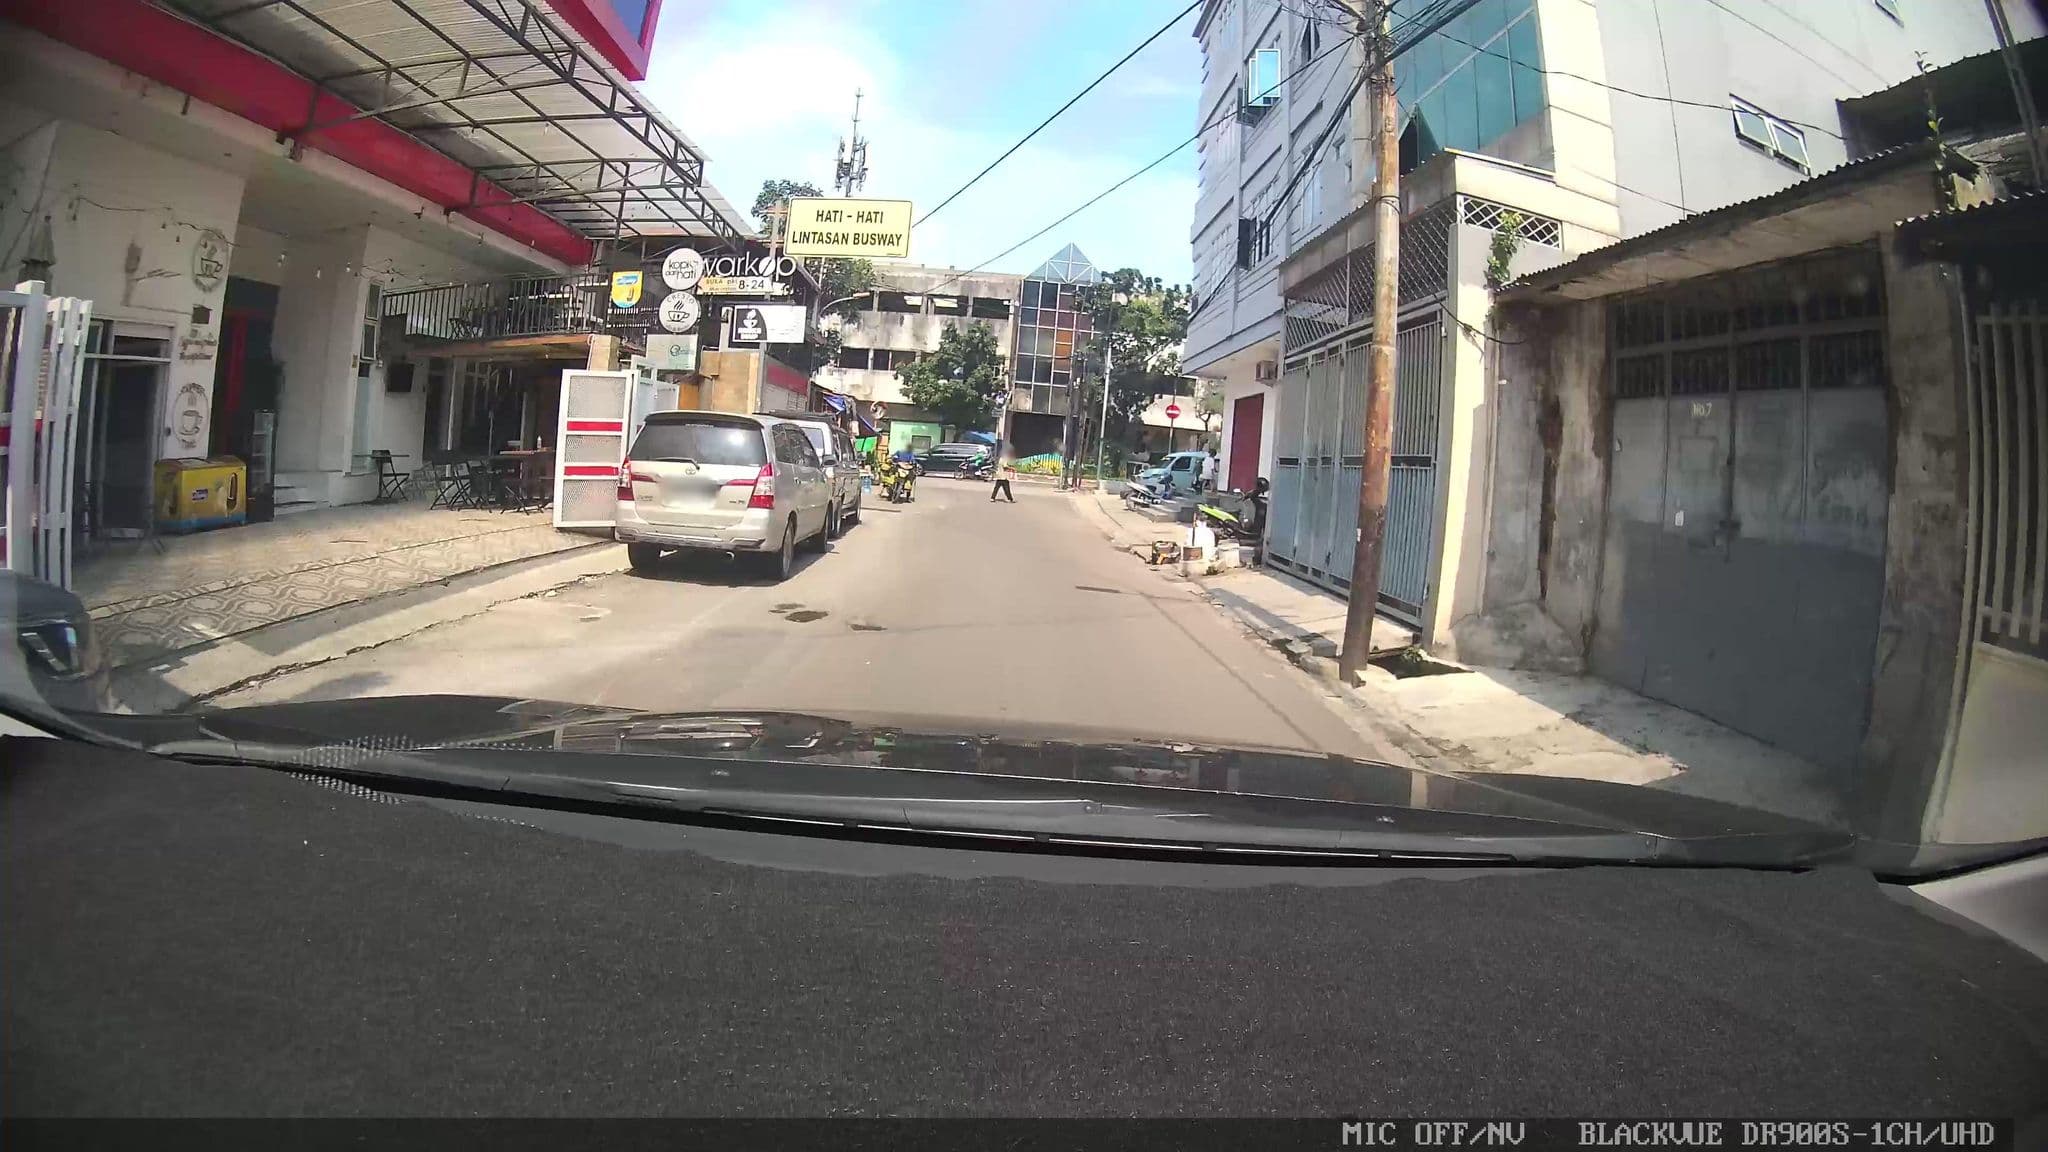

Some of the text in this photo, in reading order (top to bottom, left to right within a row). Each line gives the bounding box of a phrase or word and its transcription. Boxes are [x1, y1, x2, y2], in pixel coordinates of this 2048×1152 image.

[816, 210, 843, 223] HATI
[856, 211, 884, 224] HATI
[792, 231, 903, 247] LINTASAN BUSWAY
